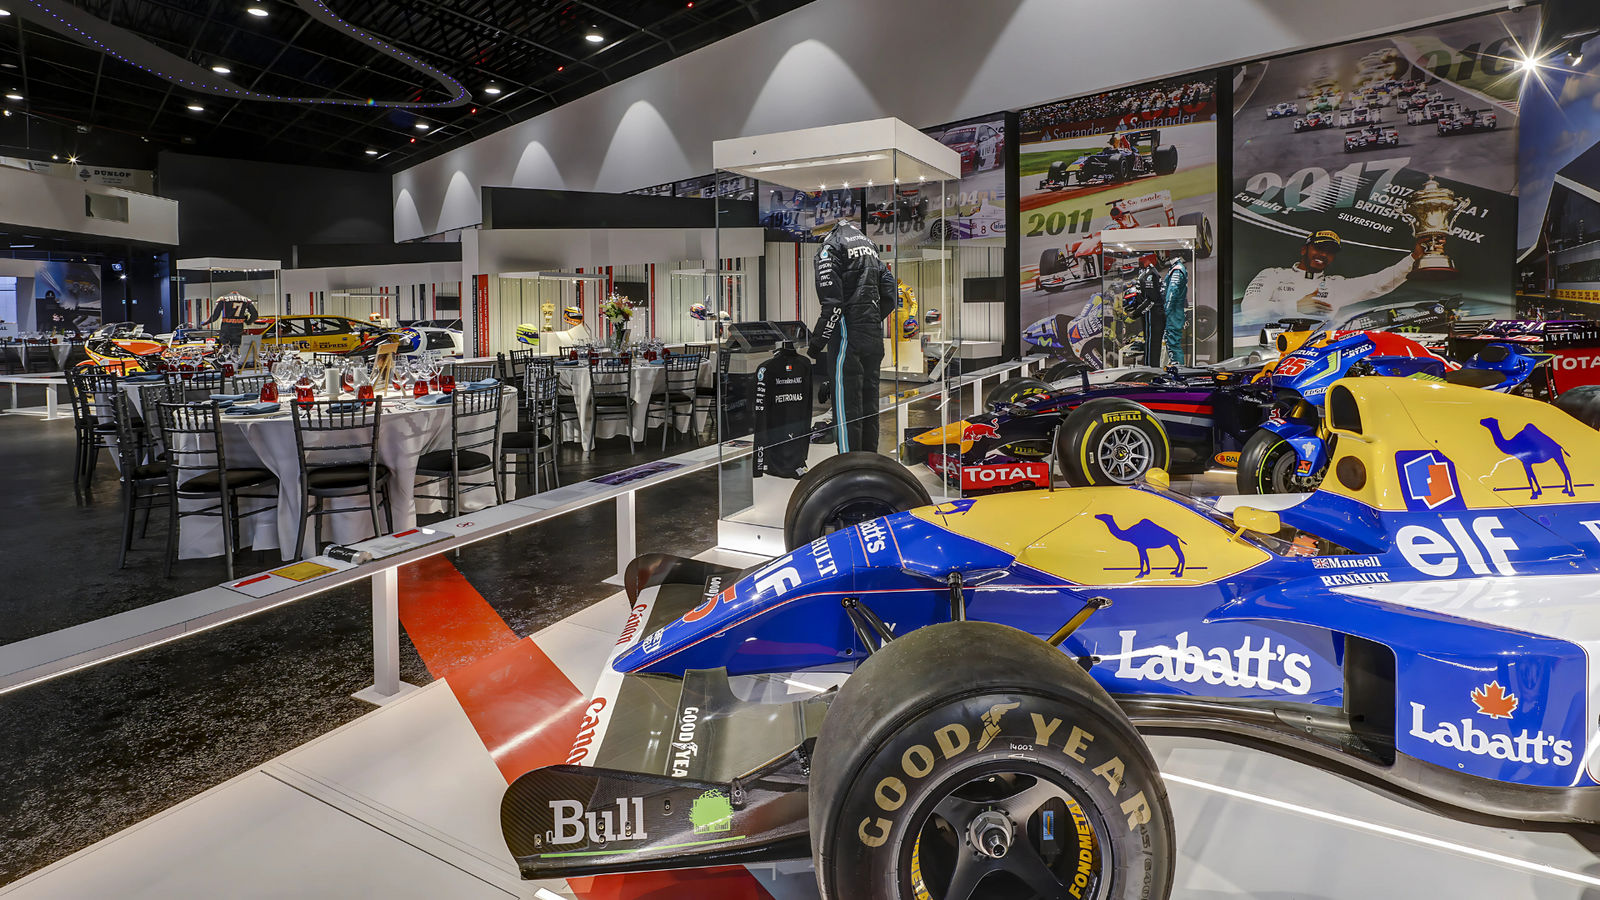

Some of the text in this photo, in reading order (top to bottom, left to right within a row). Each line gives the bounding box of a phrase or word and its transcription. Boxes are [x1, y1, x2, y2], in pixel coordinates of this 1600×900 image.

[94, 169, 131, 178] DUNLOP
[1245, 157, 1411, 214] 2017
[1234, 192, 1282, 213] Formula
[1026, 208, 1093, 237] 2011
[1337, 211, 1394, 234] SILVERSTONE
[1354, 199, 1400, 220] BRITISH
[1450, 226, 1485, 243] PRIX
[233, 302, 243, 317] 7
[822, 306, 842, 339] INEOS
[1273, 356, 1311, 376] 25
[1552, 355, 1600, 371] TOTA
[1101, 410, 1142, 424] PIRELLI
[964, 466, 1041, 482] TOTAL
[1396, 516, 1520, 577] elf
[1328, 556, 1382, 569] Mansell
[753, 554, 803, 597] lf
[1320, 571, 1392, 587] RENAULT
[615, 603, 647, 645] Canon
[1115, 630, 1312, 695] Labatt's
[1409, 701, 1574, 766] Labatt's
[1009, 743, 1034, 751] 14002
[549, 797, 647, 845] Bull
